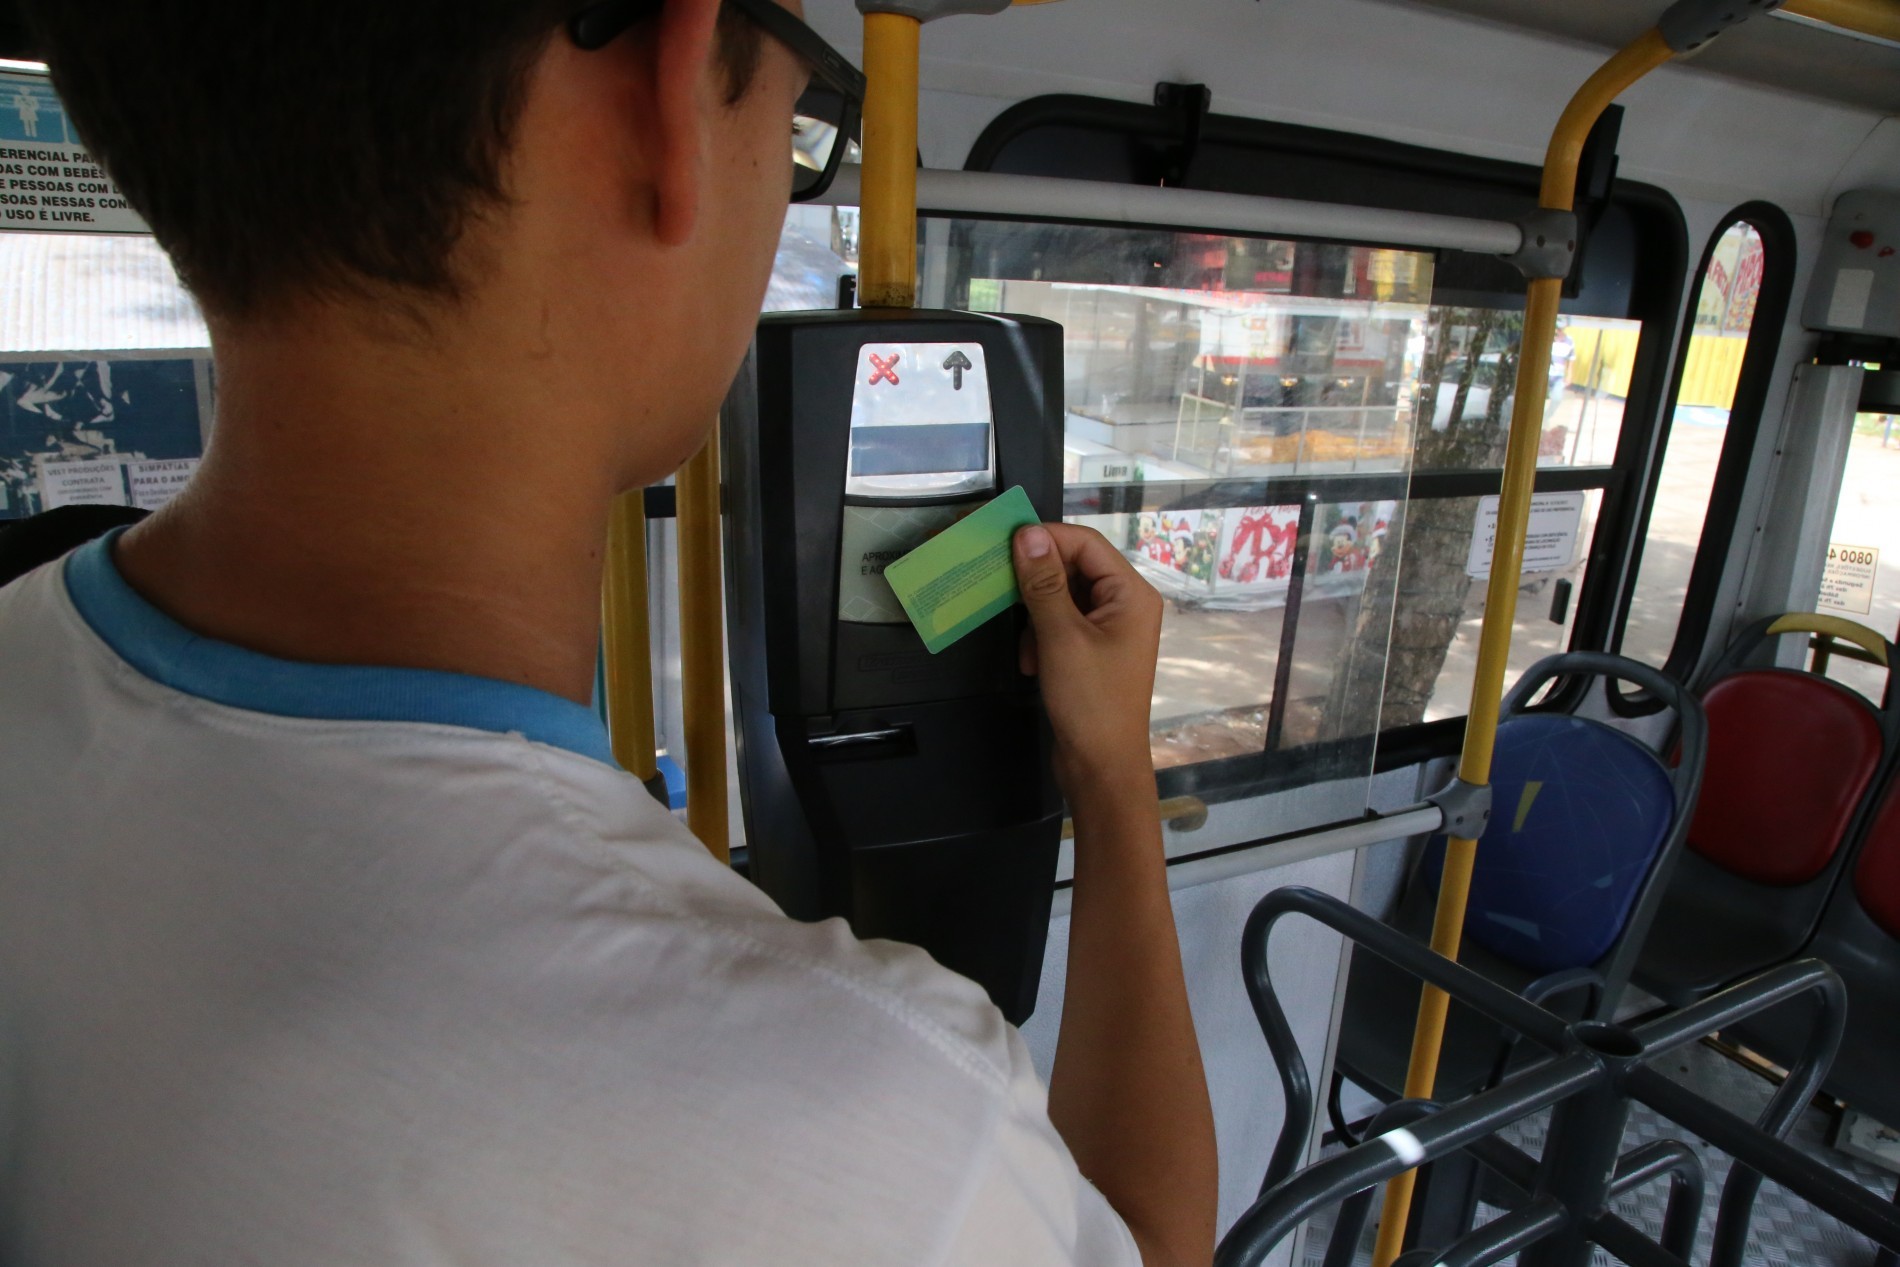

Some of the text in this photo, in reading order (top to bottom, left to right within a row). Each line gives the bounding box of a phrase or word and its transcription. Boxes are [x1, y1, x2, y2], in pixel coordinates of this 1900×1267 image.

[27, 165, 59, 177] COM
[9, 179, 74, 193] PESSOAS
[78, 183, 109, 194] COM
[42, 196, 95, 208] NESSAS
[99, 199, 133, 210] CON
[6, 208, 95, 223] USO É LIVRE.
[138, 462, 190, 473] SIMPATIAS
[62, 476, 105, 487] CONTRATA
[133, 476, 158, 485] PARA
[862, 566, 868, 575] E
